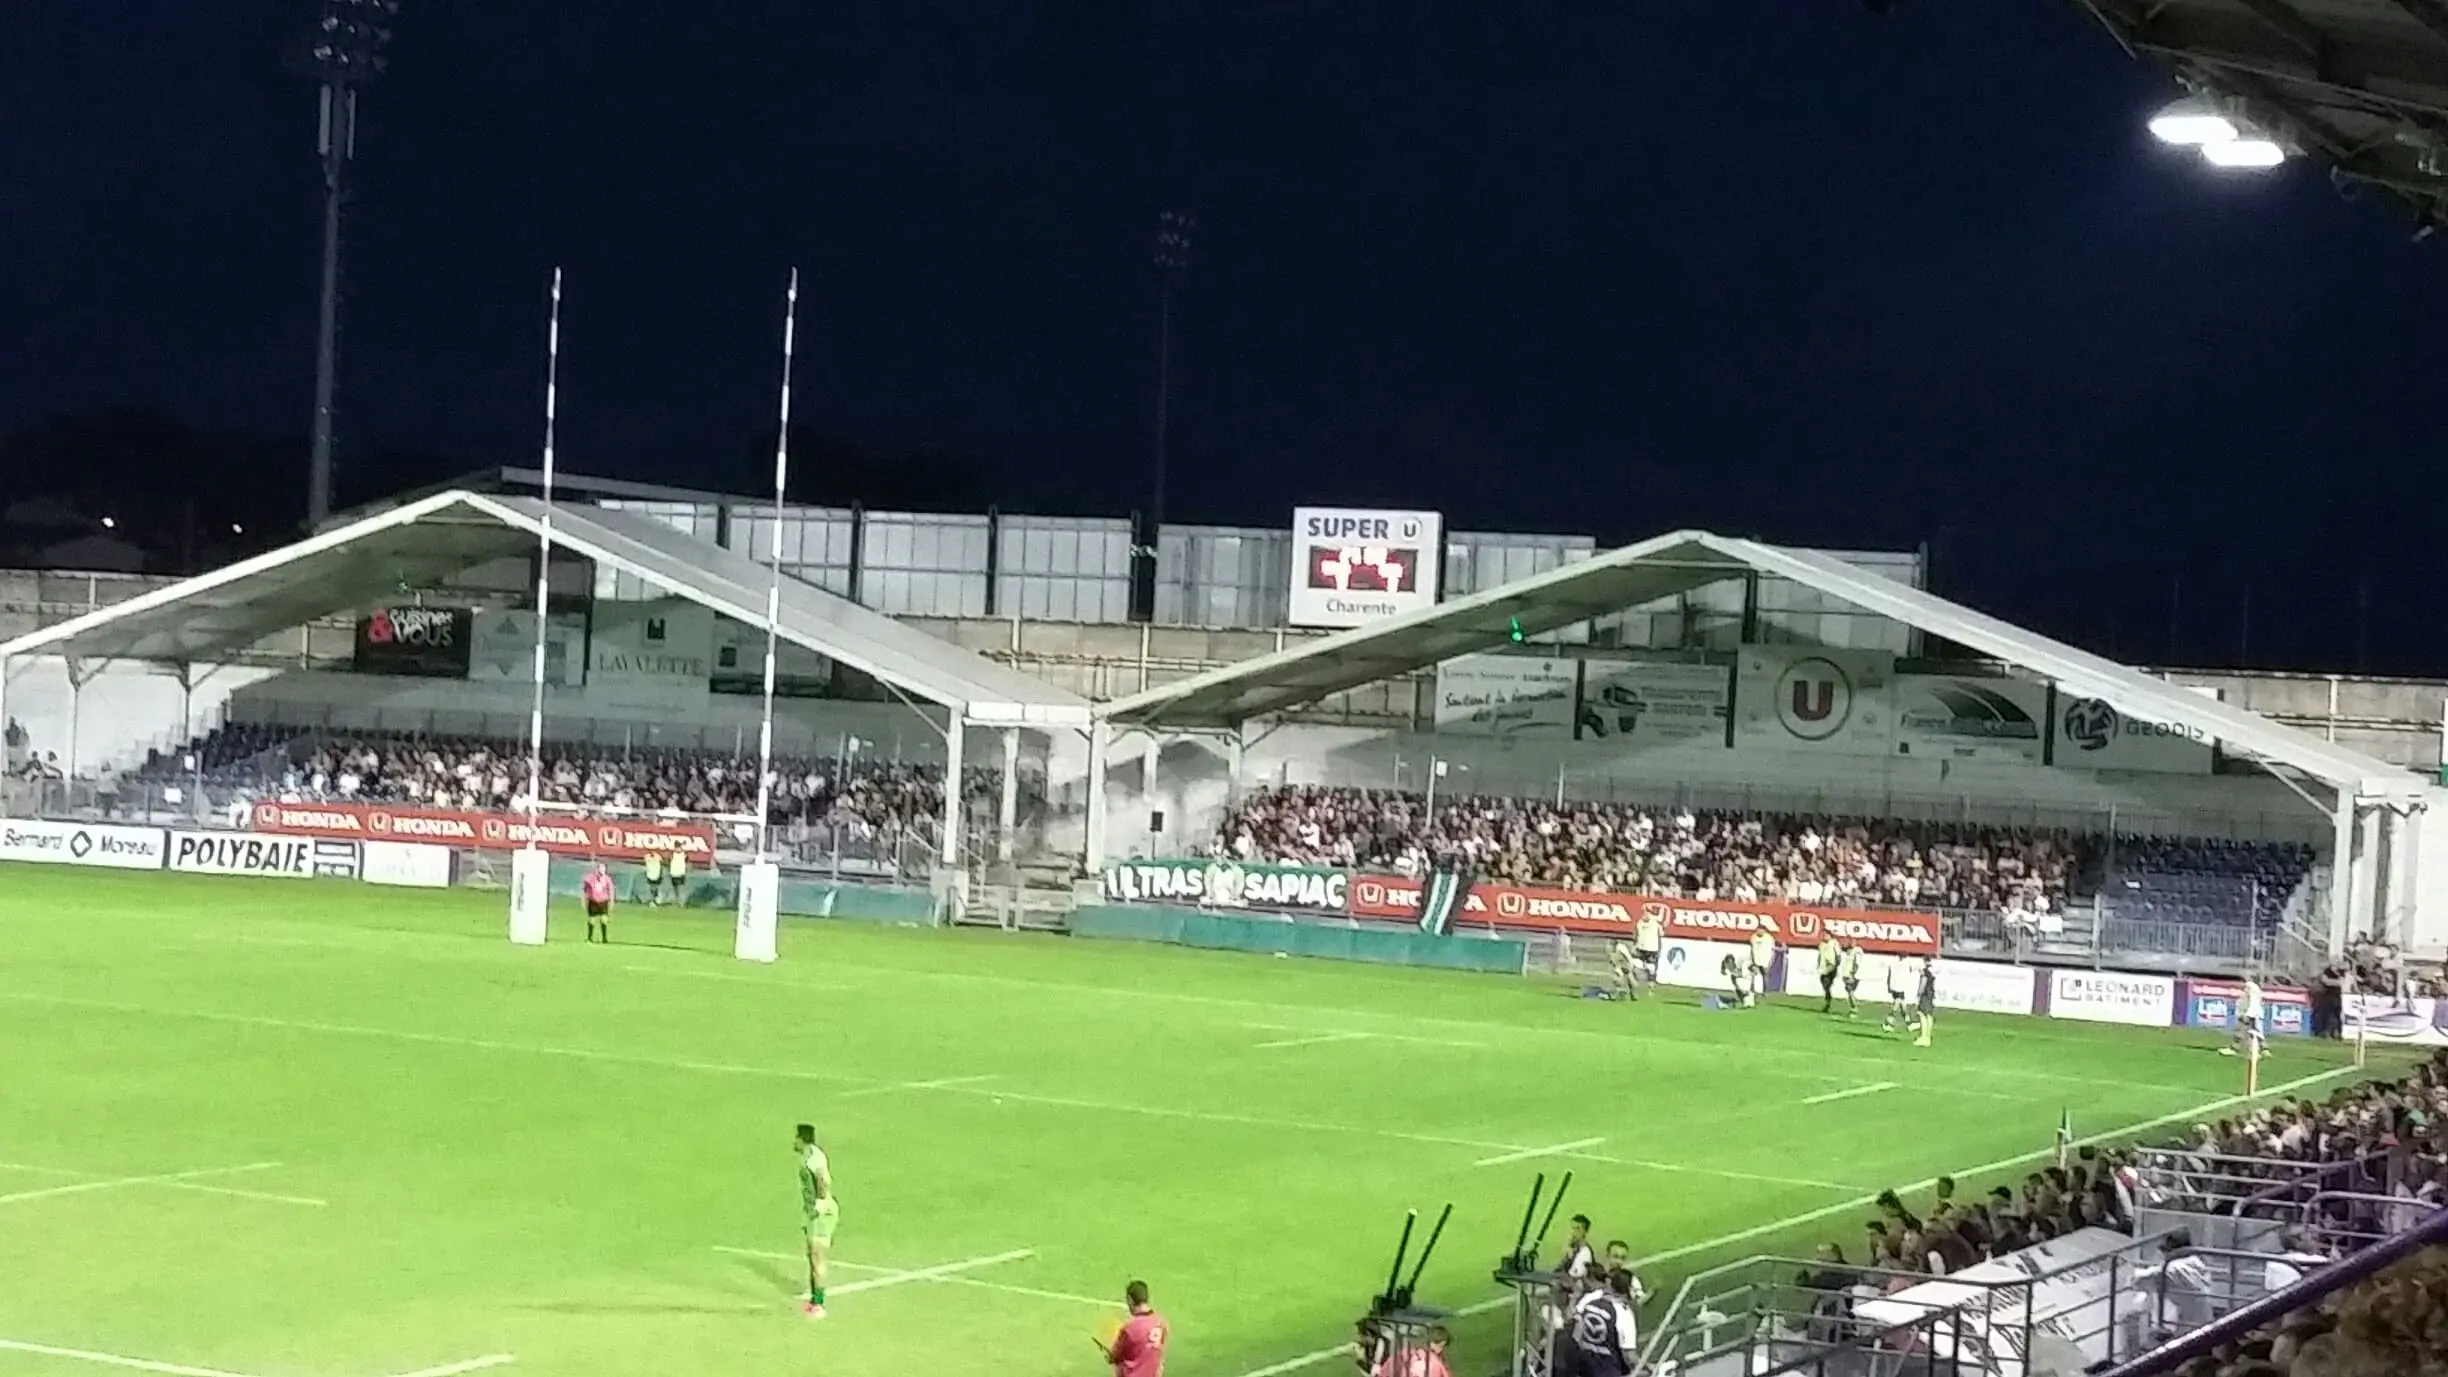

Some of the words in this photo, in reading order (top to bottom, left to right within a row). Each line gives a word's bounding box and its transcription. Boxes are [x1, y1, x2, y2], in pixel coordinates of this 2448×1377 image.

[1308, 517, 1389, 539] SUPER
[1326, 598, 1396, 616] Charente
[599, 653, 703, 676] LAVALETTE
[281, 810, 361, 831] HONDA
[393, 816, 476, 837] HONDA
[177, 837, 308, 873] POLYBAIE
[1244, 873, 1347, 909] SAPIAC
[1528, 898, 1632, 922] HONDA
[1673, 908, 1780, 932] HONDA
[1823, 919, 1933, 943] HONDA
[2086, 980, 2165, 997] LEONARD
